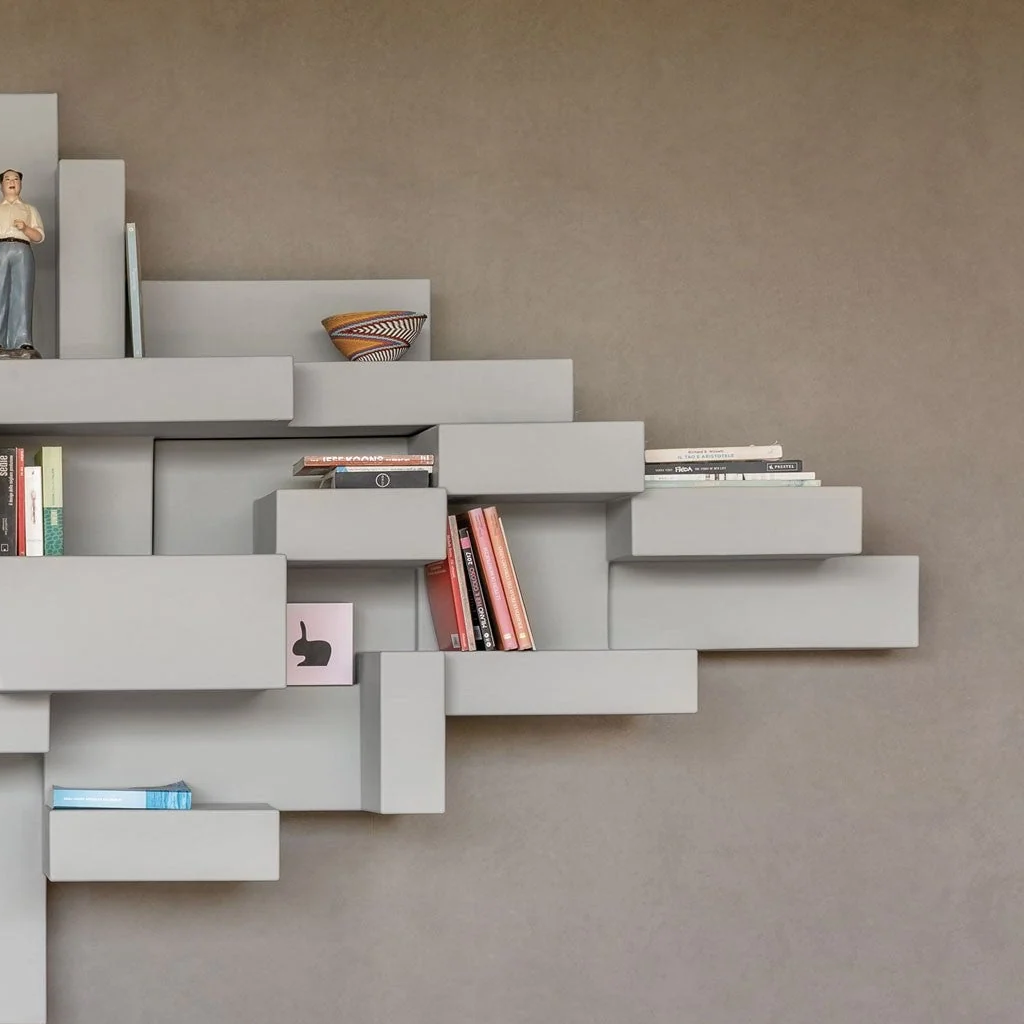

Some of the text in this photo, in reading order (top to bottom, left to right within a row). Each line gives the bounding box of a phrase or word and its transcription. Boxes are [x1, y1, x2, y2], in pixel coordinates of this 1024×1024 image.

[465, 551, 473, 565] 2017
[469, 567, 479, 591] GOLOSO
[477, 606, 486, 628] MILANO
